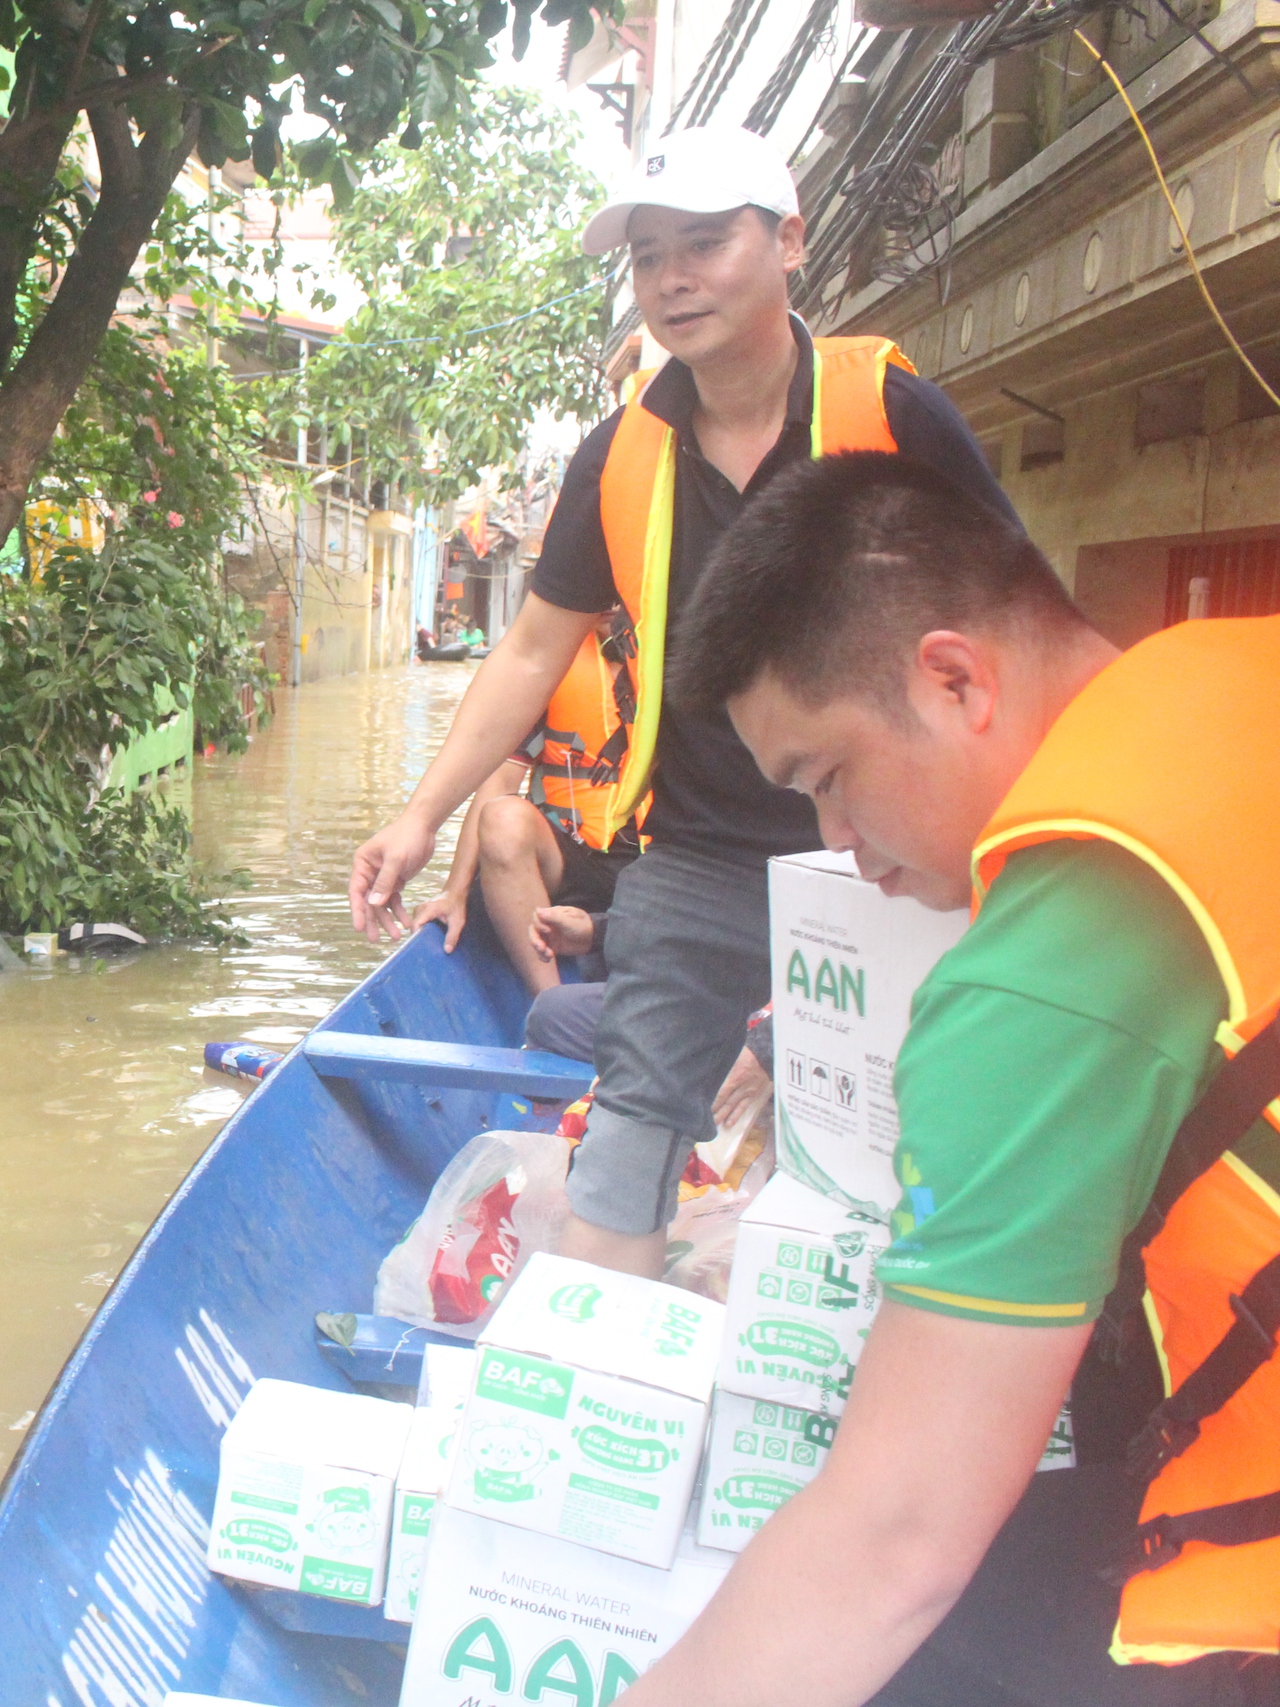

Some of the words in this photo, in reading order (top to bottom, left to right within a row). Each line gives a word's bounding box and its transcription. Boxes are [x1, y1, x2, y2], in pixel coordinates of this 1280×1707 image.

[787, 947, 865, 1018] AAN
[751, 1325, 779, 1345] 3T
[484, 1360, 542, 1388] BAF
[735, 1356, 756, 1375] VỊ
[577, 1394, 658, 1433] NGUYÊN
[664, 1419, 686, 1439] VỊ
[585, 1429, 607, 1447] XÚC
[610, 1439, 638, 1456] XÍCH
[636, 1449, 665, 1469] 3T
[728, 1480, 755, 1499] 3T
[711, 1509, 732, 1528] VỊ
[229, 1523, 250, 1537] 3T
[217, 1545, 232, 1560] VỊ
[236, 1549, 295, 1575] NGUYÊN
[323, 1576, 367, 1596] BAF
[500, 1570, 572, 1603] MINERAL
[575, 1586, 632, 1616] WATER
[468, 1582, 508, 1608] NƯỚC
[509, 1592, 569, 1625] KHOÁNG
[571, 1608, 612, 1635] THIÊN
[614, 1617, 658, 1643] NHIÊN
